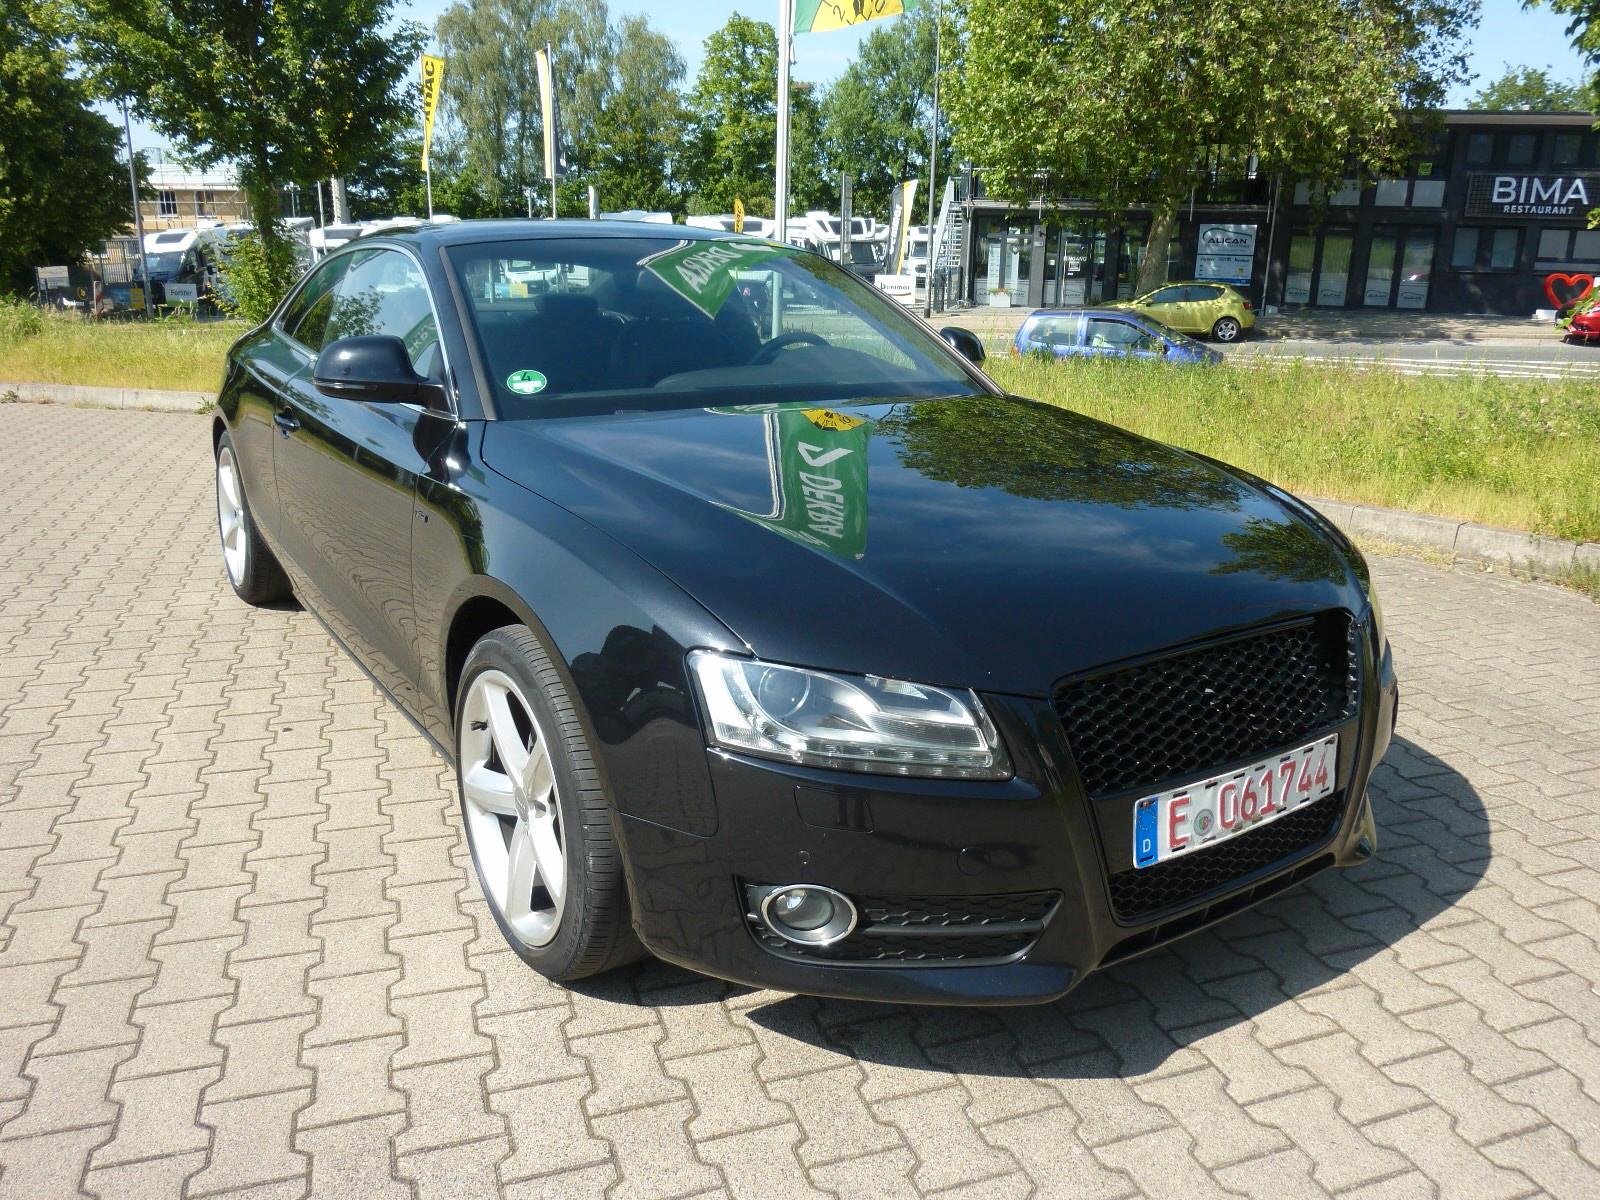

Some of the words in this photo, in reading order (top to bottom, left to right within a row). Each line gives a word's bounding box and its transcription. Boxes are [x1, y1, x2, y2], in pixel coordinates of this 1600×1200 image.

[1491, 176, 1589, 205] BIMA
[1503, 205, 1575, 215] RESTAURANT
[1167, 796, 1192, 850] E
[1217, 752, 1329, 831] 061744
